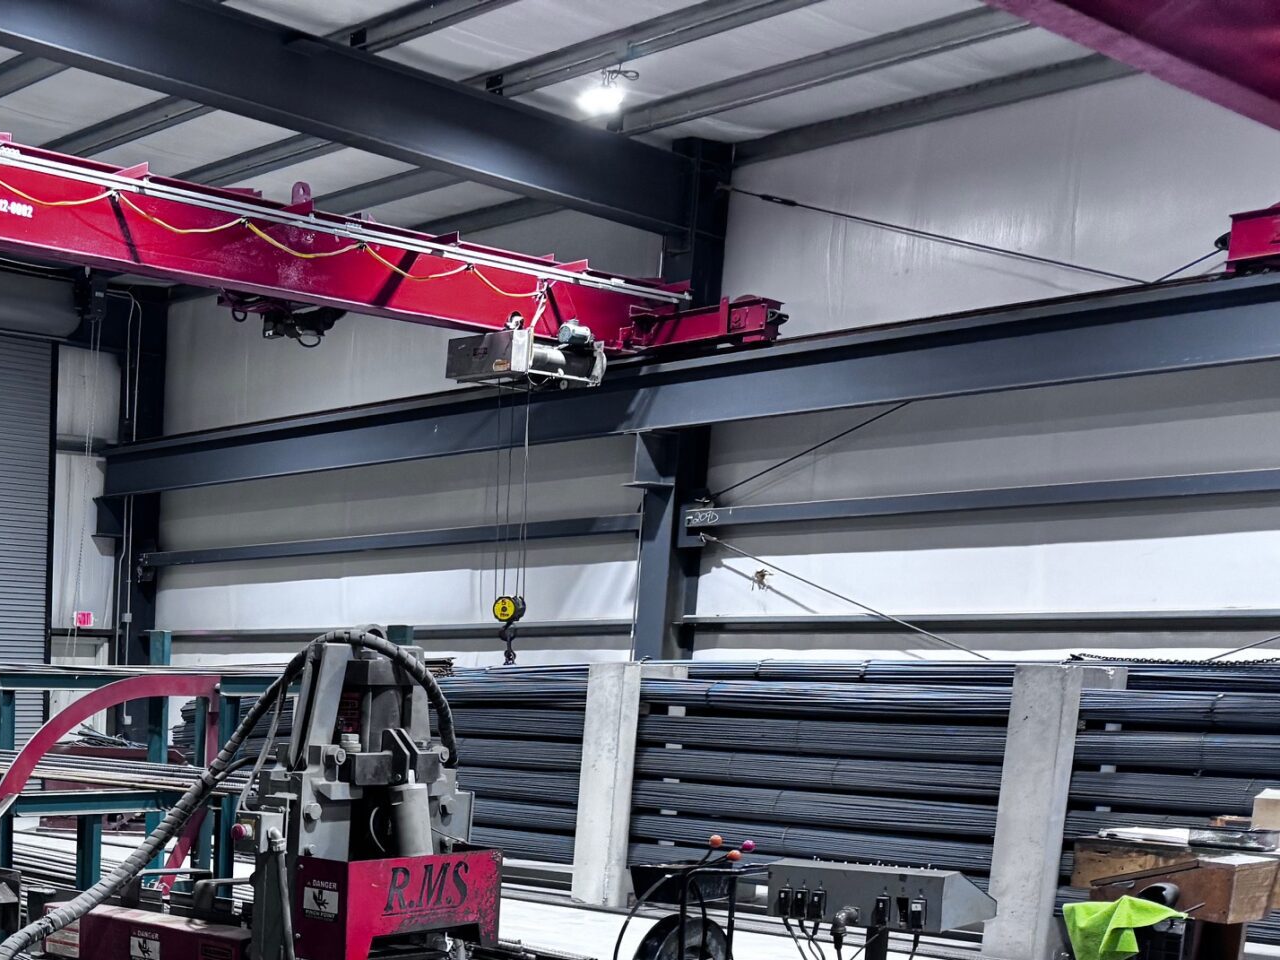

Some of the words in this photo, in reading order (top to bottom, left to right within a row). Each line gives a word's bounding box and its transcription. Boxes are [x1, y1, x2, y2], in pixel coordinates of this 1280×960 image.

[312, 879, 337, 890] DANGER
[383, 861, 469, 913] R.M.S
[137, 930, 159, 940] DANGER
